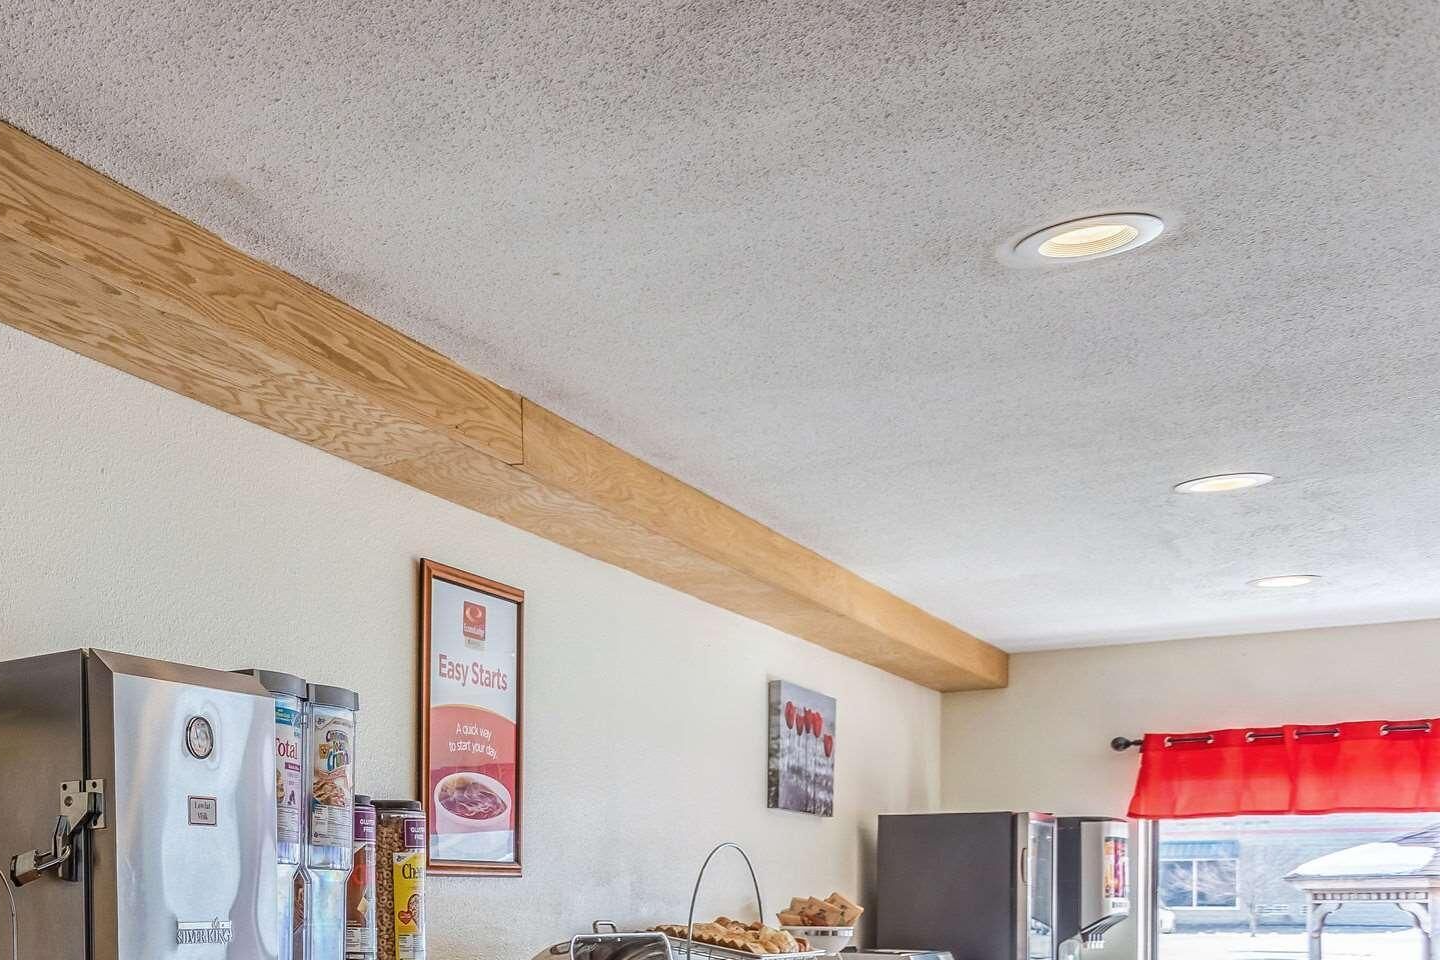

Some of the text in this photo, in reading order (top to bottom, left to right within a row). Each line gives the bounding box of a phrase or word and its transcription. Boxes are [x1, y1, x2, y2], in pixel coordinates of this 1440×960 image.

[439, 653, 508, 691] Easy Starts
[456, 723, 492, 741] A quick way
[449, 742, 456, 752] to
[457, 740, 471, 752] start
[472, 742, 486, 754] your
[206, 928, 232, 944] KING
